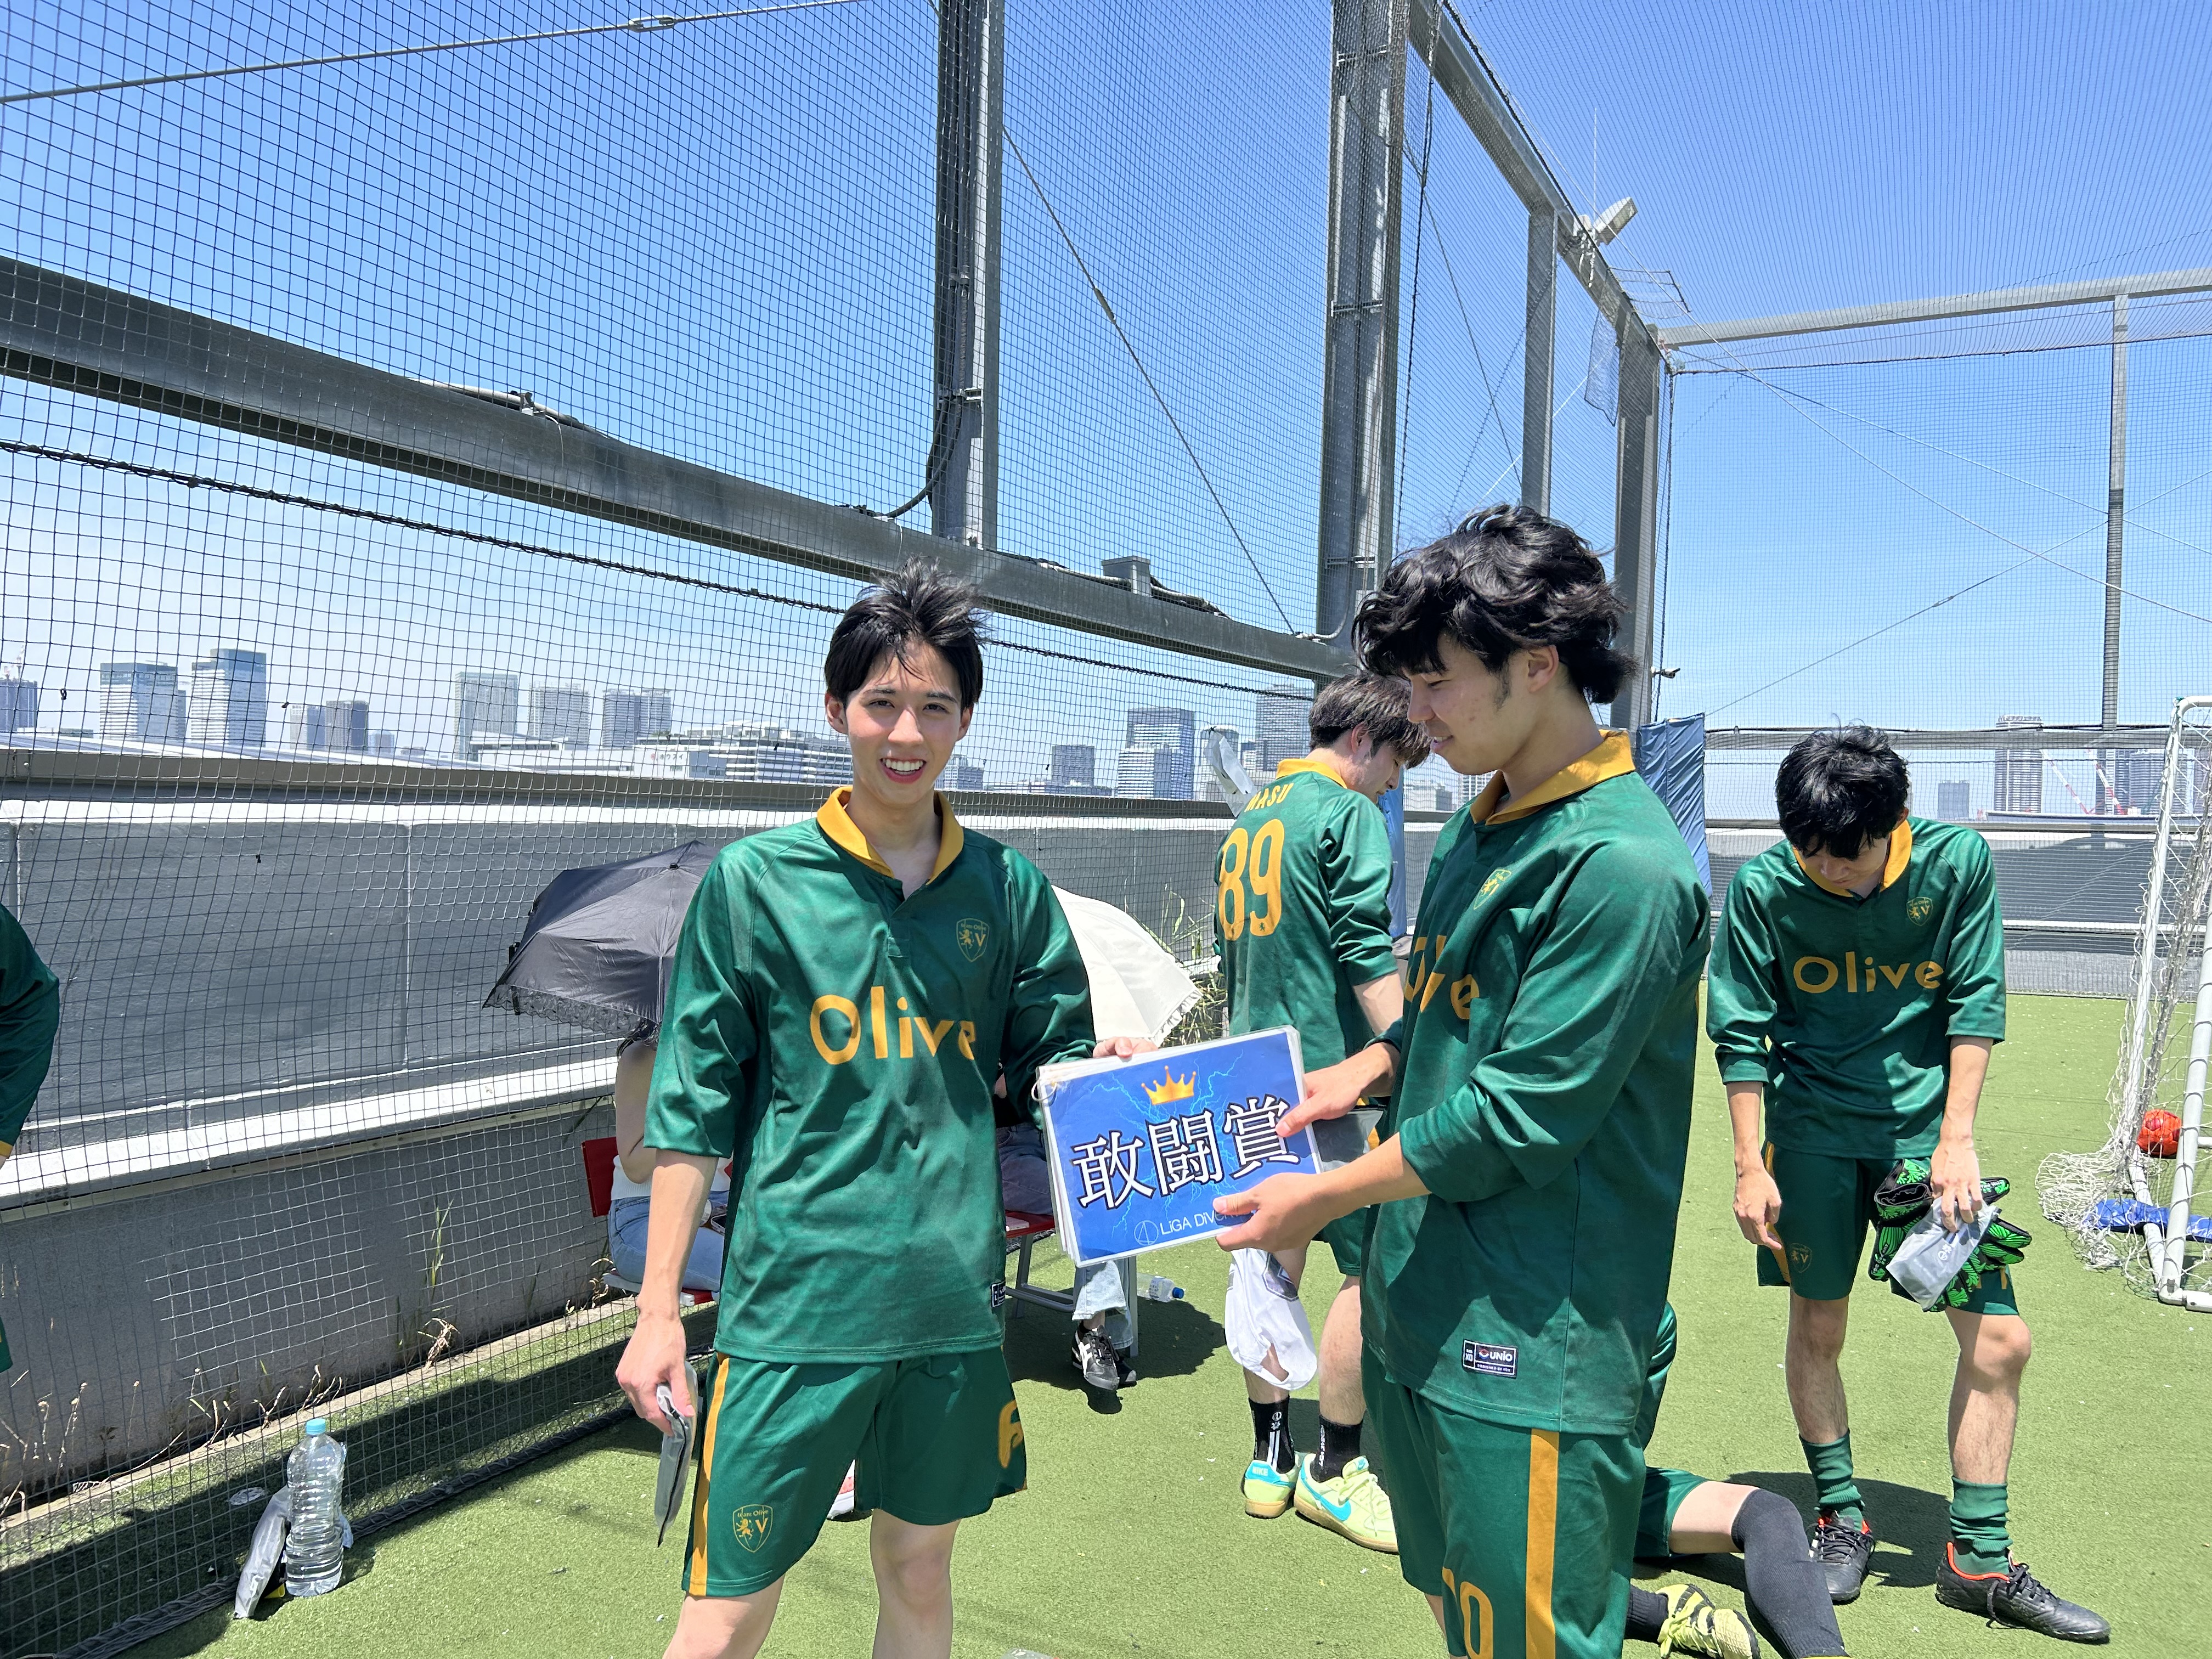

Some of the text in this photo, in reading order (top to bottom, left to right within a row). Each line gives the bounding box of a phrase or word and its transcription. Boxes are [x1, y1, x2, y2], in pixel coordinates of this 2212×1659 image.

[1244, 782, 1294, 812] MASU
[1218, 819, 1285, 941] 89
[1793, 951, 1944, 994] Olive
[1071, 1093, 1301, 1210] 敢闘賞
[1252, 1465, 1269, 1476] NIKE
